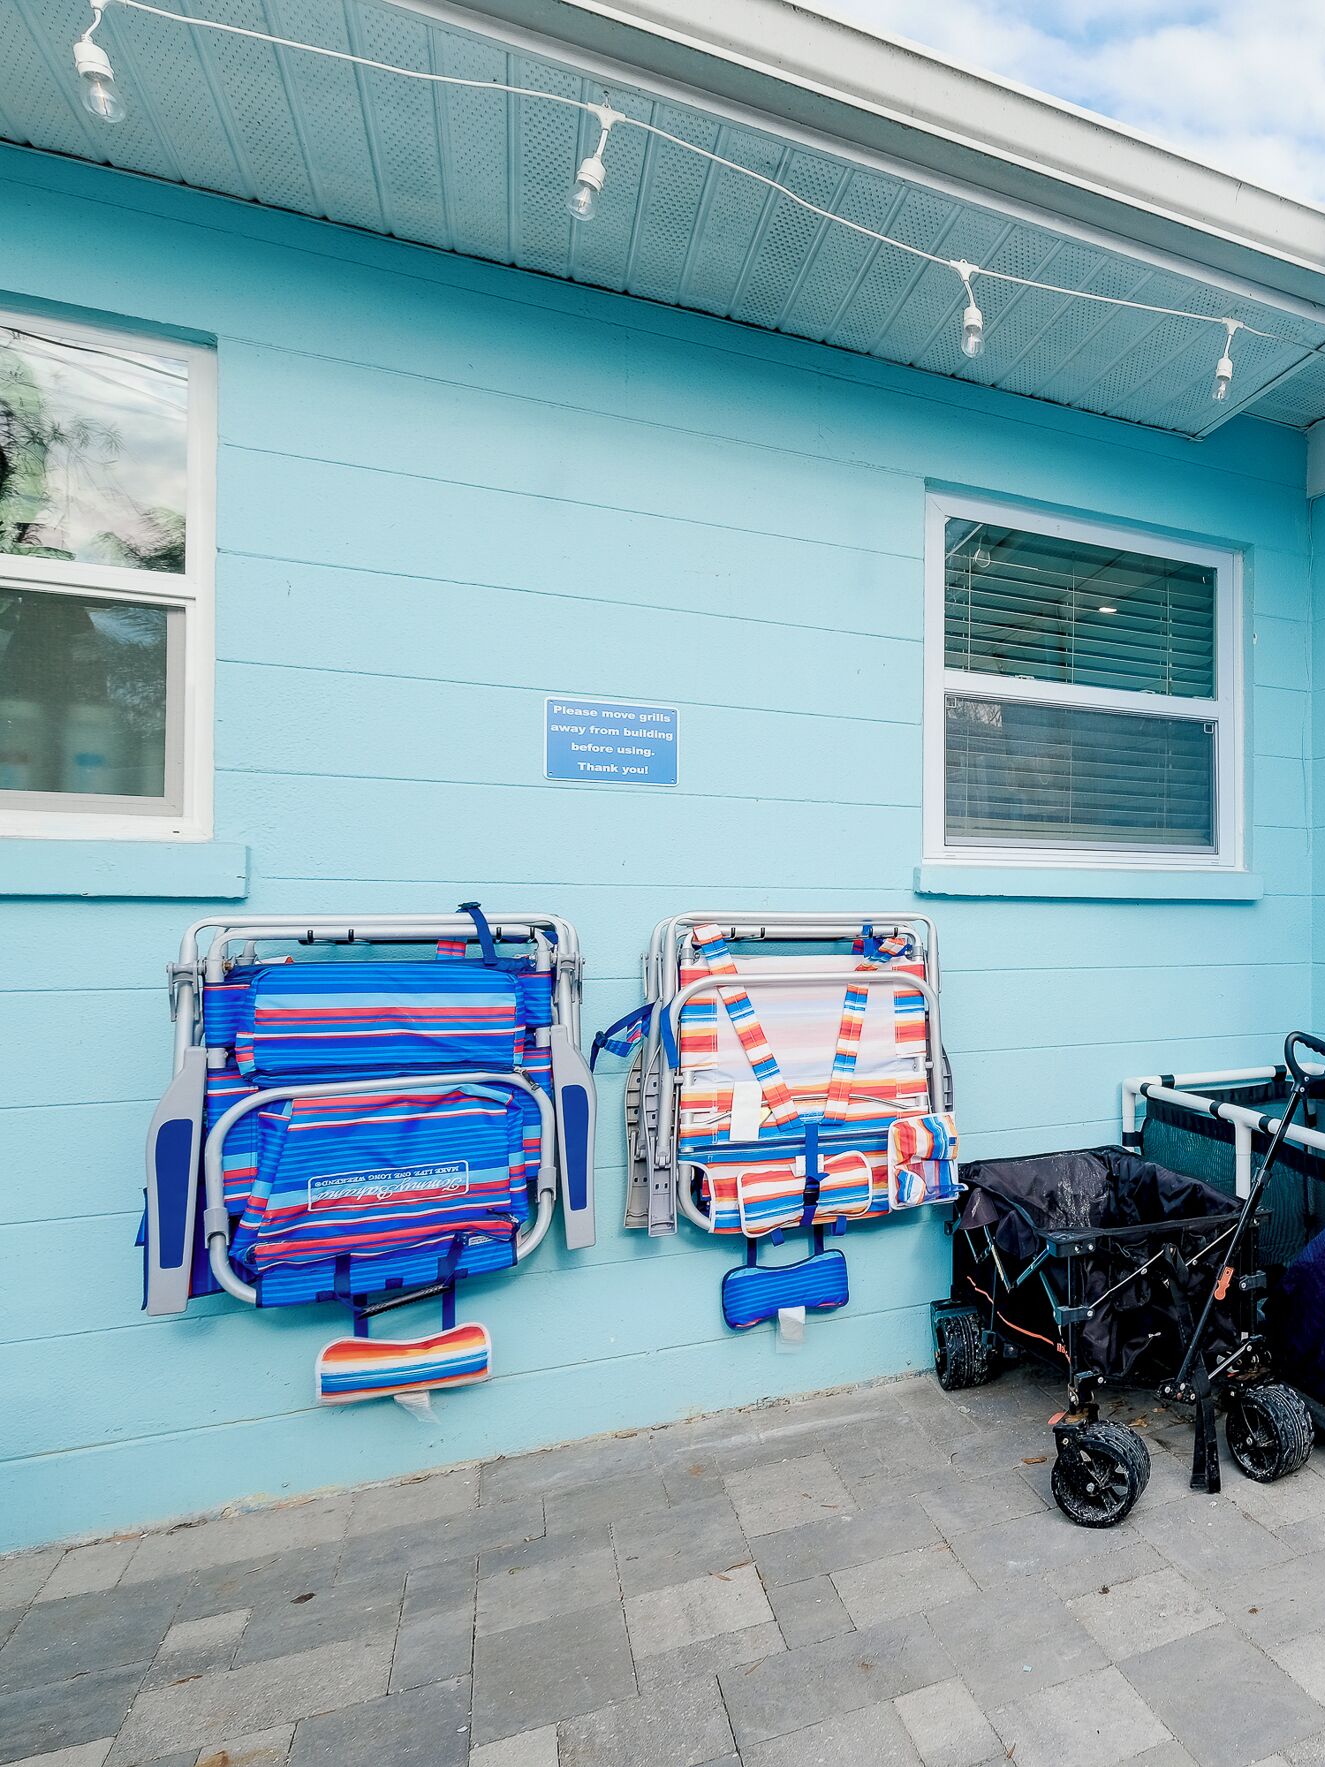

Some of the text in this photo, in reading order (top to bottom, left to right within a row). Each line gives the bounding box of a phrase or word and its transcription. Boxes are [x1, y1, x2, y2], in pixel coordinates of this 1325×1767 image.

[553, 705, 671, 723] Please move grills
[550, 724, 673, 741] away from building
[571, 742, 655, 757] before using.
[577, 762, 649, 775] Thank you!
[394, 1171, 411, 1179] ONE
[415, 1169, 433, 1177] LIFE
[435, 1166, 459, 1174] MAKE
[368, 1173, 392, 1181] LONG
[316, 1177, 463, 1201] Tommy Bahama
